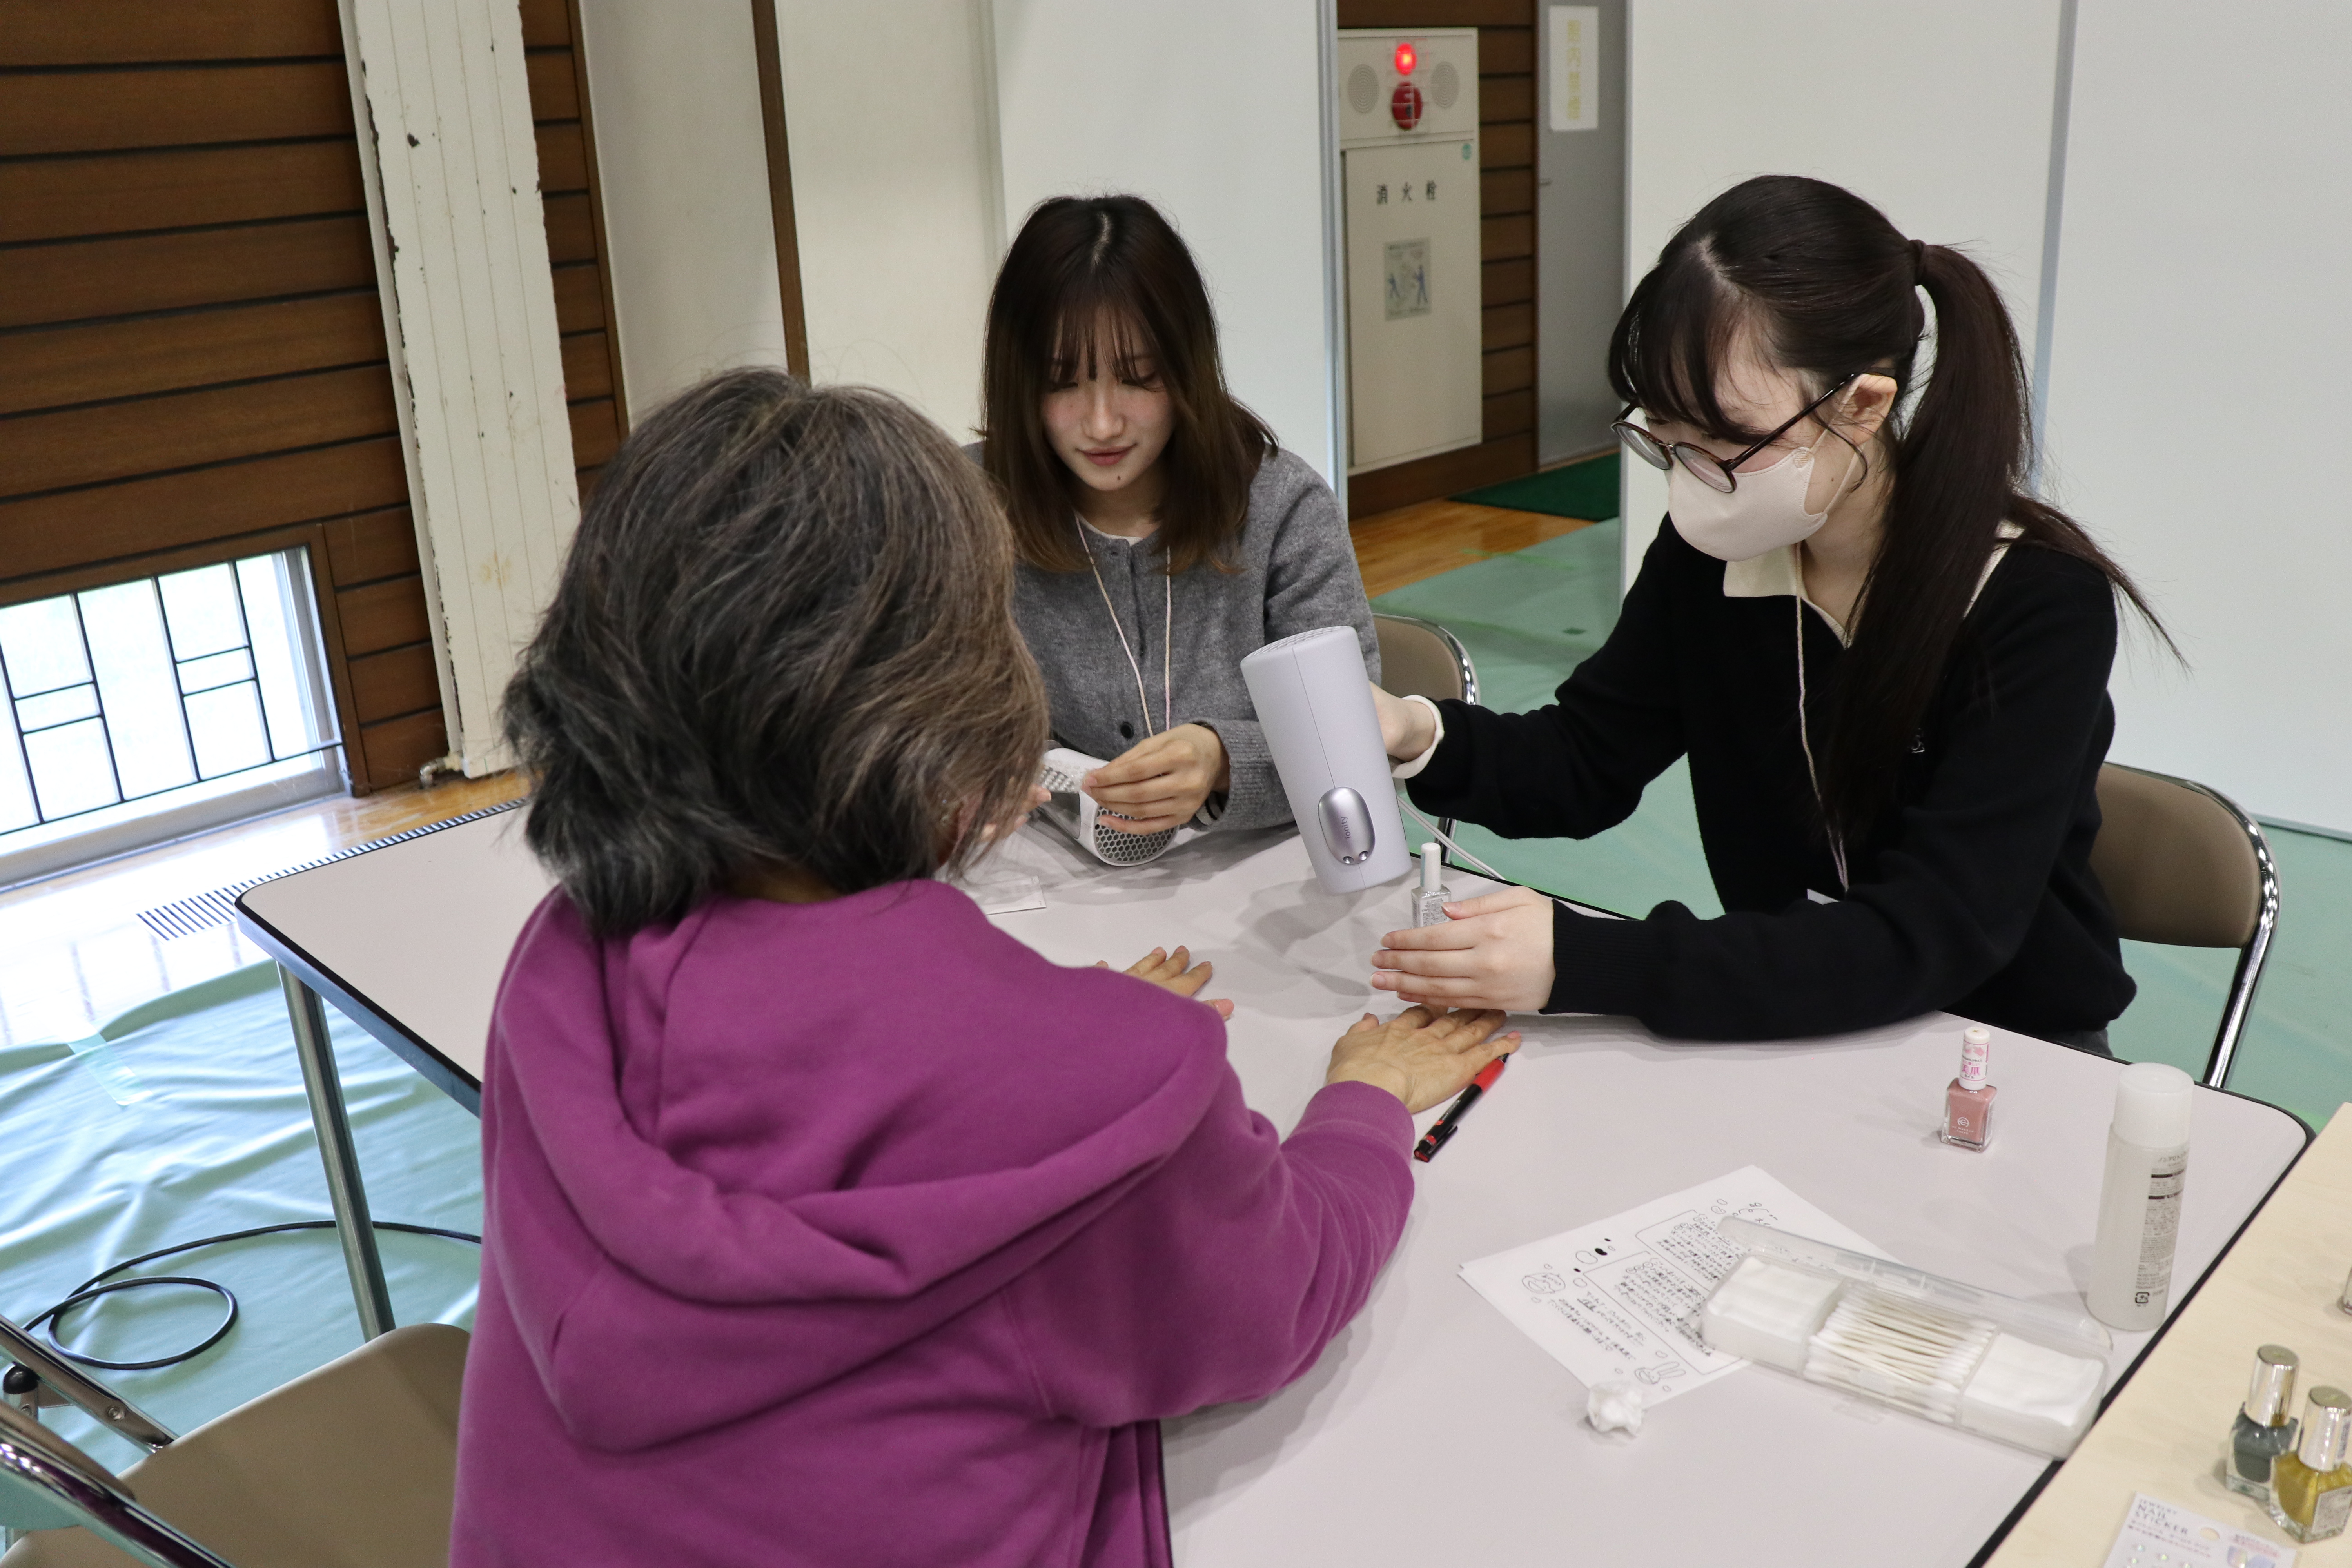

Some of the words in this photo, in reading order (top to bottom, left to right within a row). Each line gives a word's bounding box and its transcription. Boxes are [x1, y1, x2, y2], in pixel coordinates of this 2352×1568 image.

[1377, 180, 1437, 205] 消火栓
[1341, 817, 1351, 839] ionity
[2136, 1511, 2188, 1535] STICKER
[2138, 1504, 2166, 1520] NAIL
